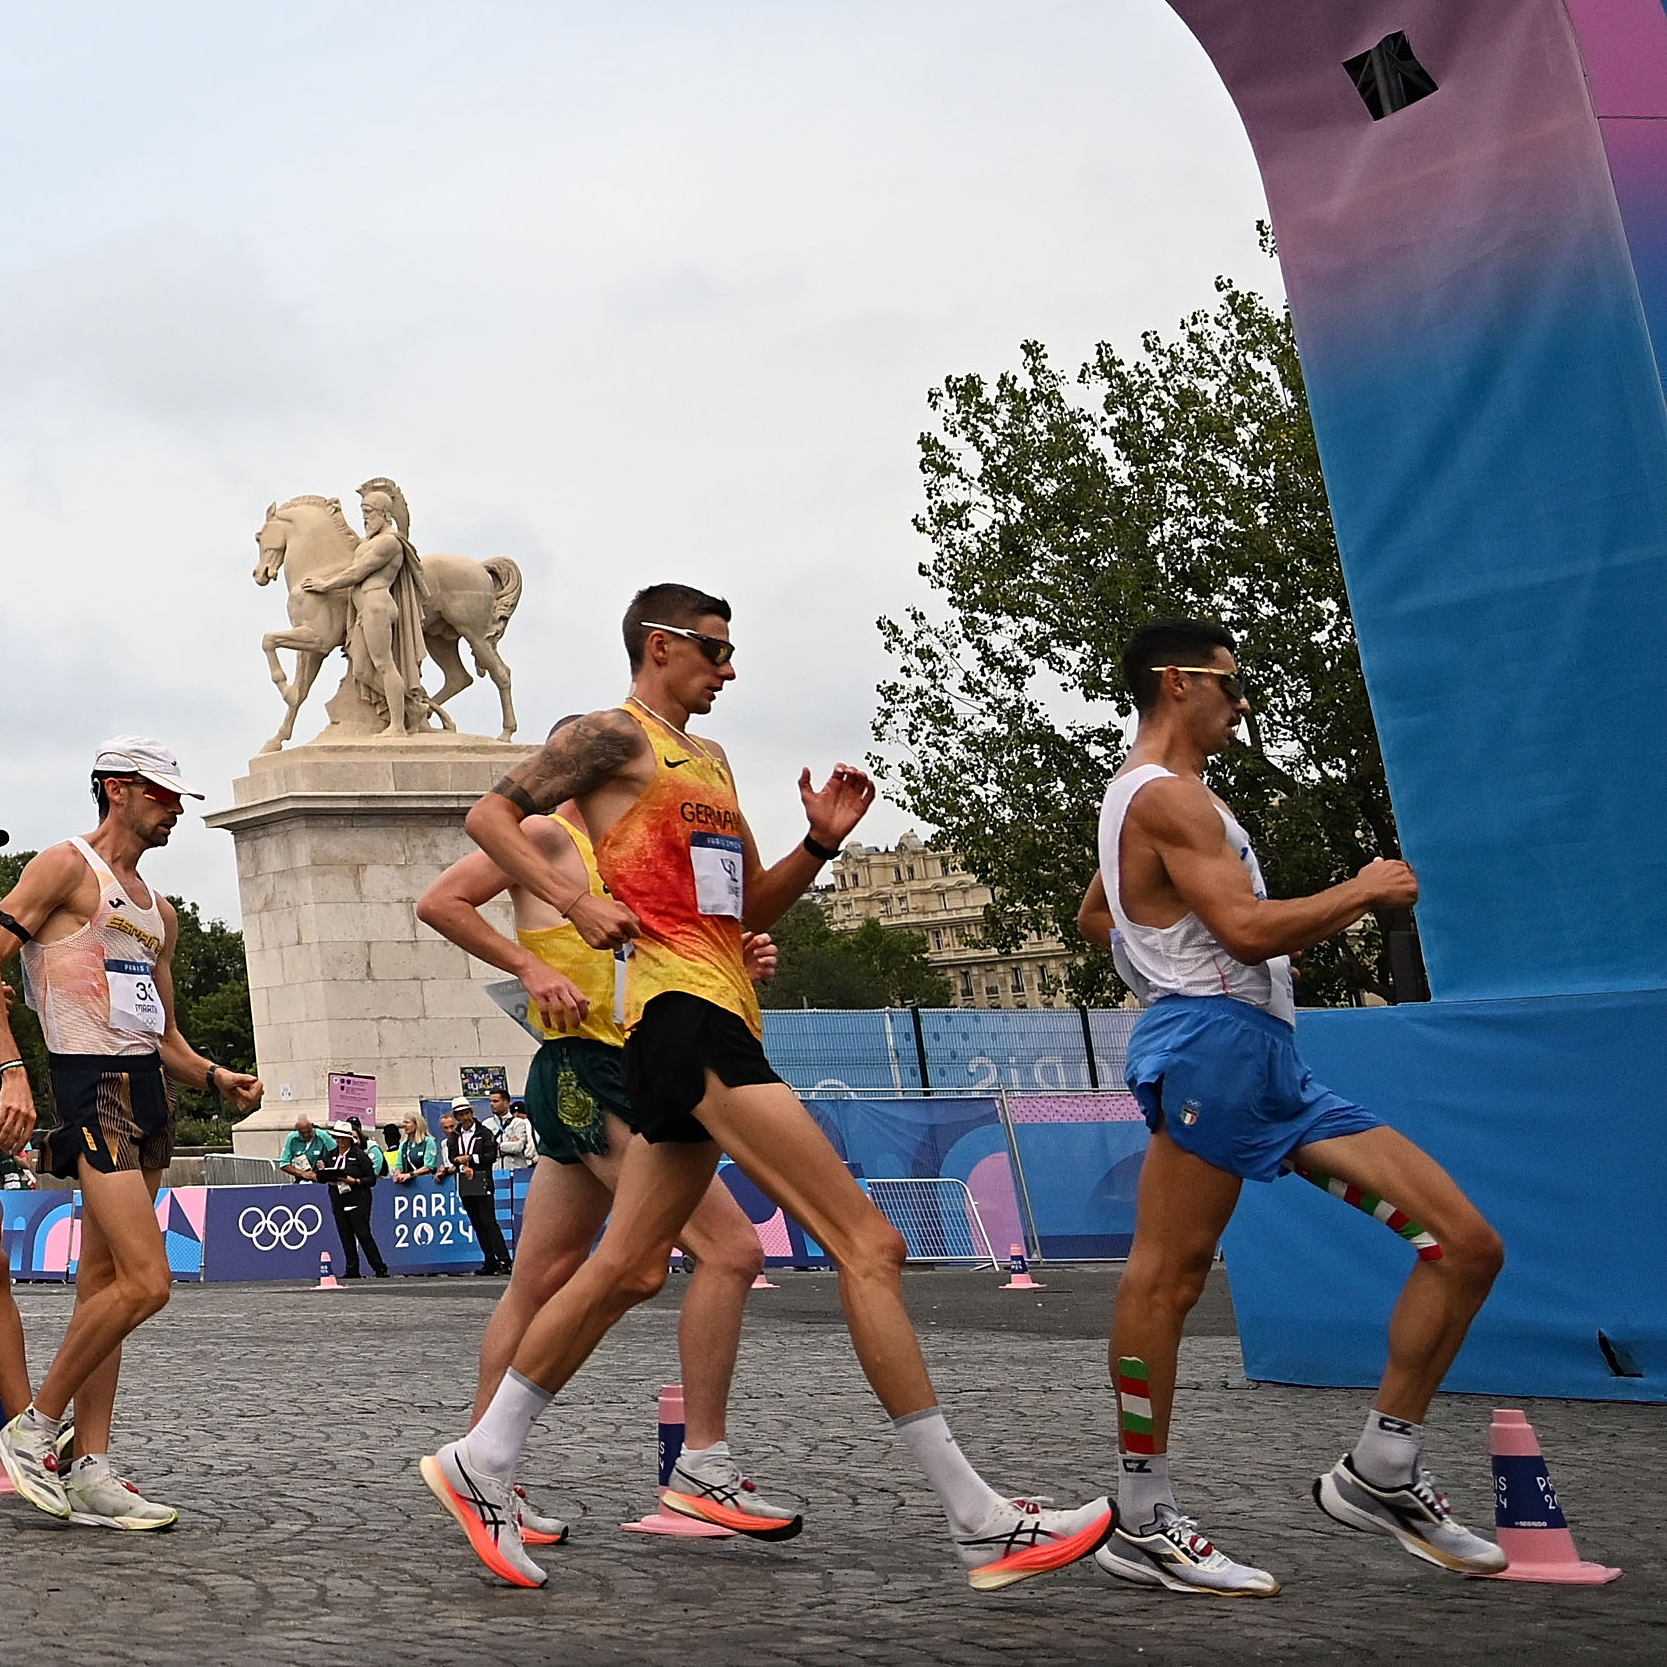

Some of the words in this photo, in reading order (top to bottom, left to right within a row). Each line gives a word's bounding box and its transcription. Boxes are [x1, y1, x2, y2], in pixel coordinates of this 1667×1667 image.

[395, 1220, 473, 1248] 2024
[1378, 1416, 1413, 1436] CZ
[1122, 1458, 1152, 1474] CZ
